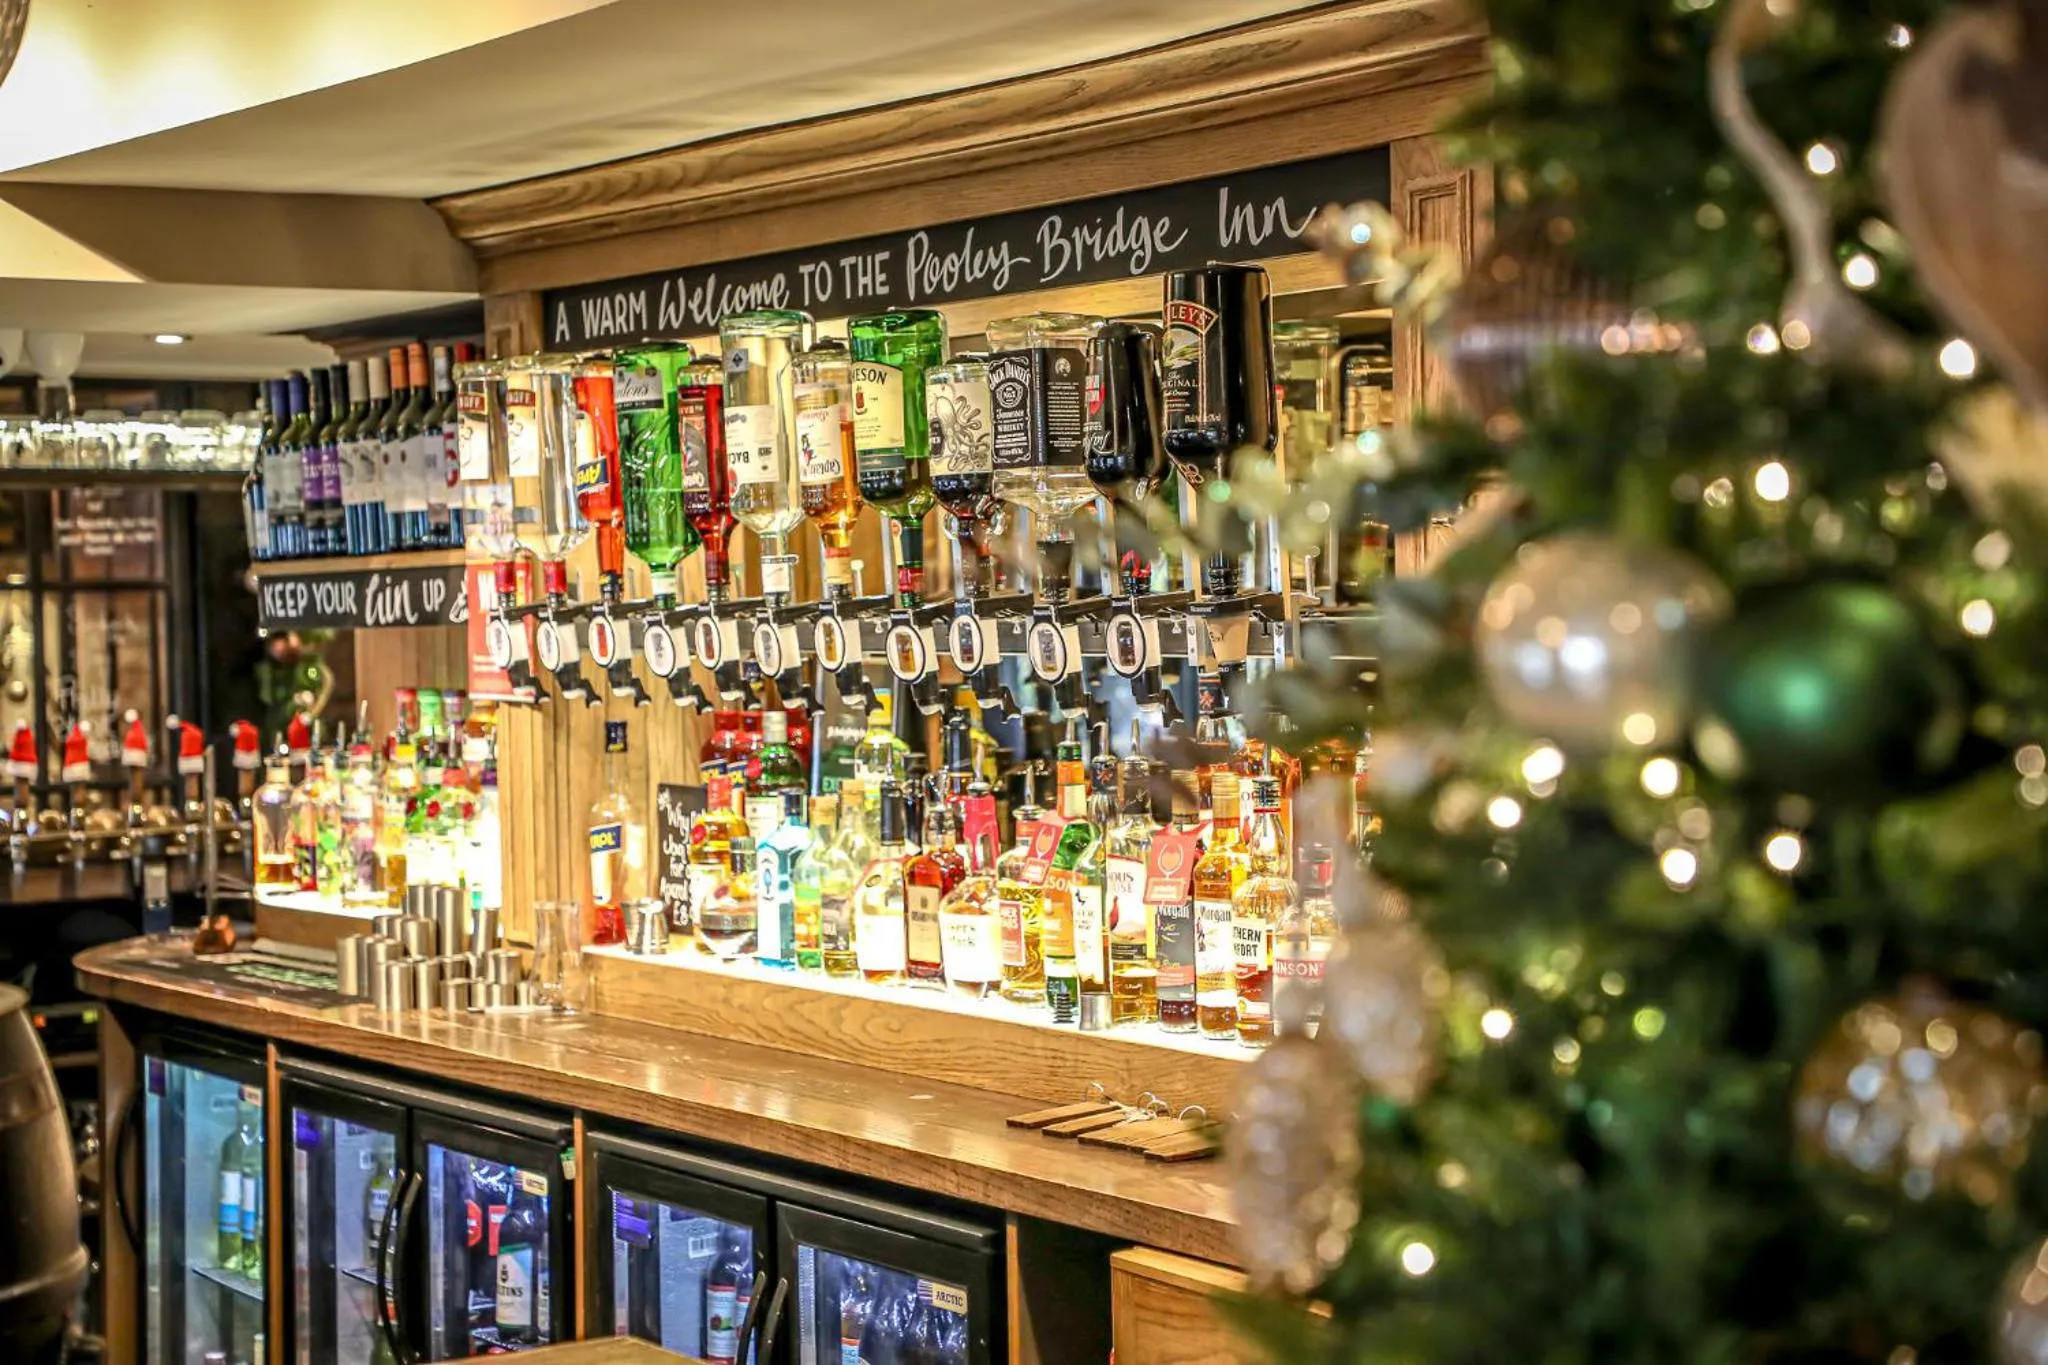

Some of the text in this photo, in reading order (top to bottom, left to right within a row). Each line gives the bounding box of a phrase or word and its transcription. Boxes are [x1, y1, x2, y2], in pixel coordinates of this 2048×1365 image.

[556, 187, 1317, 343] A WARM Welcome TO THE Pooley Bridge Inn
[1171, 304, 1208, 326] LEYS
[264, 581, 309, 618] KEEP
[312, 580, 357, 616] YOUR
[422, 578, 446, 612] UP
[936, 1290, 964, 1307] ARCTIC
